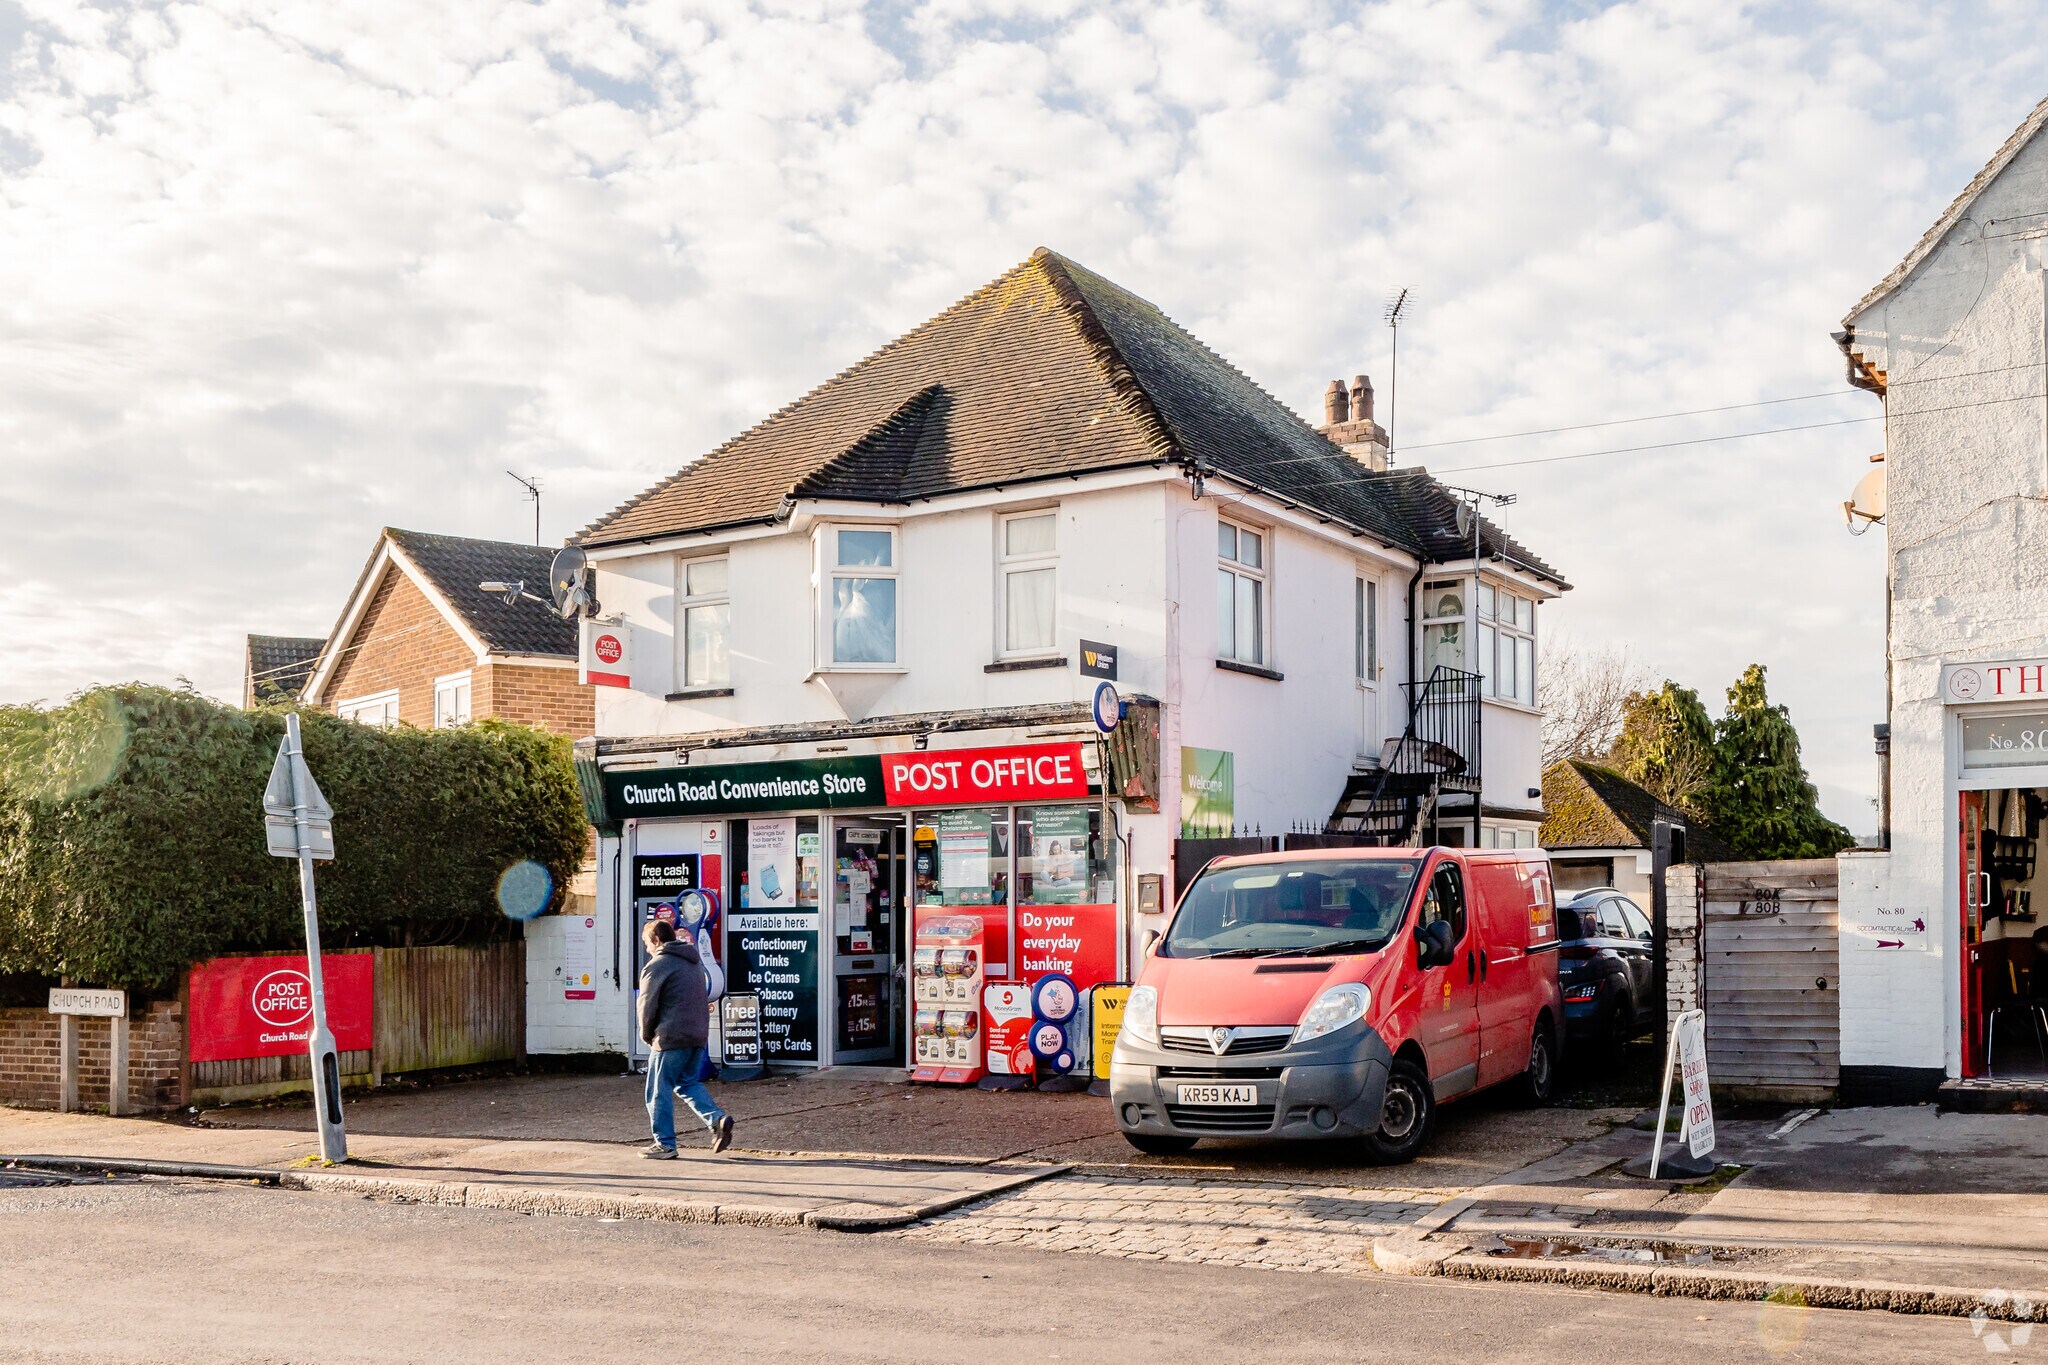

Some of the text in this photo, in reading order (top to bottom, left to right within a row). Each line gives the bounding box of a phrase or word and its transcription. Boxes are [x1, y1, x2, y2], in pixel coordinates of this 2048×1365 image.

[601, 640, 617, 649] POST
[597, 648, 619, 658] OFFICE
[1097, 661, 1109, 669] Union
[893, 755, 1074, 792] POST OFFICE
[623, 773, 866, 804] Church Road Convenience Store
[1188, 774, 1222, 791] Welcome
[848, 831, 860, 839] Gift
[641, 863, 689, 877] free cash
[640, 876, 689, 886] withdrawals
[1755, 888, 1780, 900] 80A
[1756, 902, 1780, 913] 80B
[1877, 907, 1905, 915] No. 80
[740, 916, 808, 929] Available here:
[1023, 912, 1074, 931] Do your
[741, 937, 807, 953] Confectionery
[1023, 933, 1081, 953] everyday
[759, 954, 789, 967] Drinks
[1023, 955, 1073, 975] banking
[748, 970, 800, 983] Ice Creams
[268, 982, 303, 996] POST
[754, 987, 793, 1000] Tobacco
[52, 994, 120, 1010] CHURCH ROAD
[260, 997, 307, 1012] OFFICE
[725, 1003, 756, 1019] free
[260, 1031, 308, 1042] Church Road
[725, 1029, 757, 1037] available
[725, 1040, 757, 1055] here
[784, 1038, 812, 1051] Cards
[1683, 1058, 1706, 1078] BARBER
[1689, 1078, 1704, 1096] SHOP
[1184, 1088, 1250, 1102] KR59 KAJ
[1690, 1100, 1710, 1126] OPEN
[1691, 1130, 1700, 1141] WET
